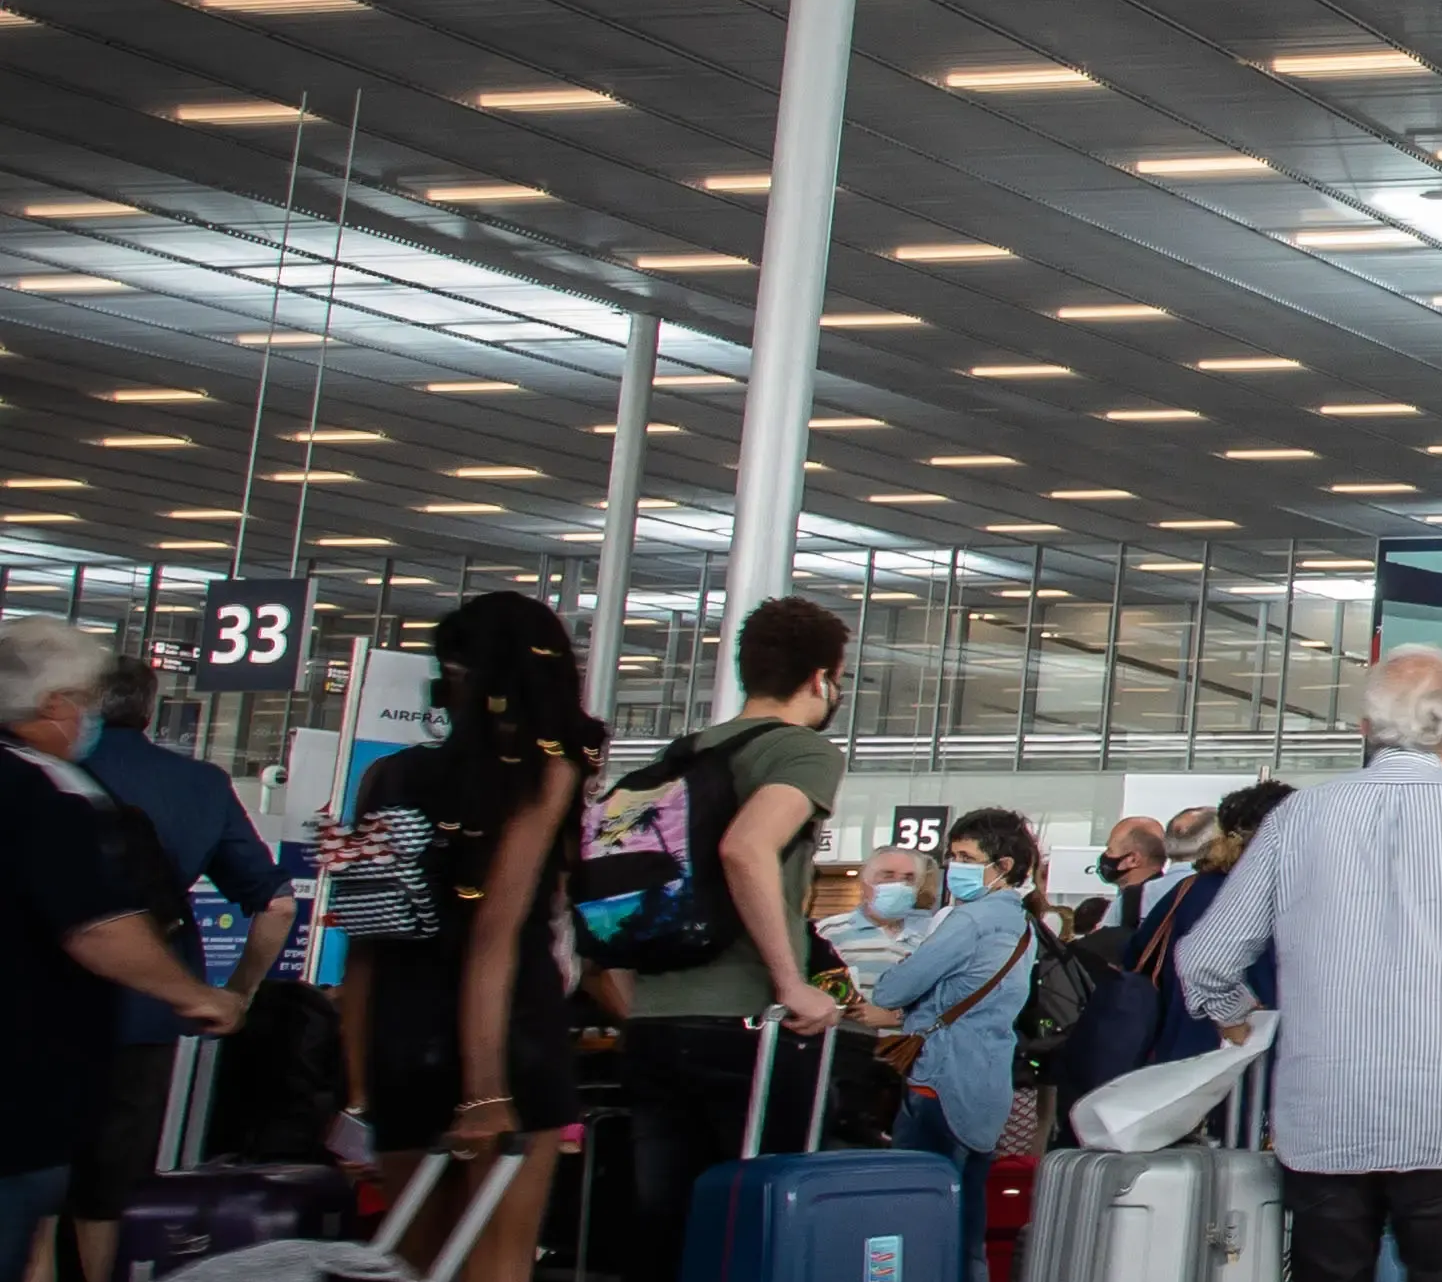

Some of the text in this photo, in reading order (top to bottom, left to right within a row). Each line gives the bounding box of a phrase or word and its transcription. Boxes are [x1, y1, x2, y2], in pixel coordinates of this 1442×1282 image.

[208, 603, 291, 664] 33
[380, 708, 450, 726] AIRFRA
[897, 818, 942, 851] 35
